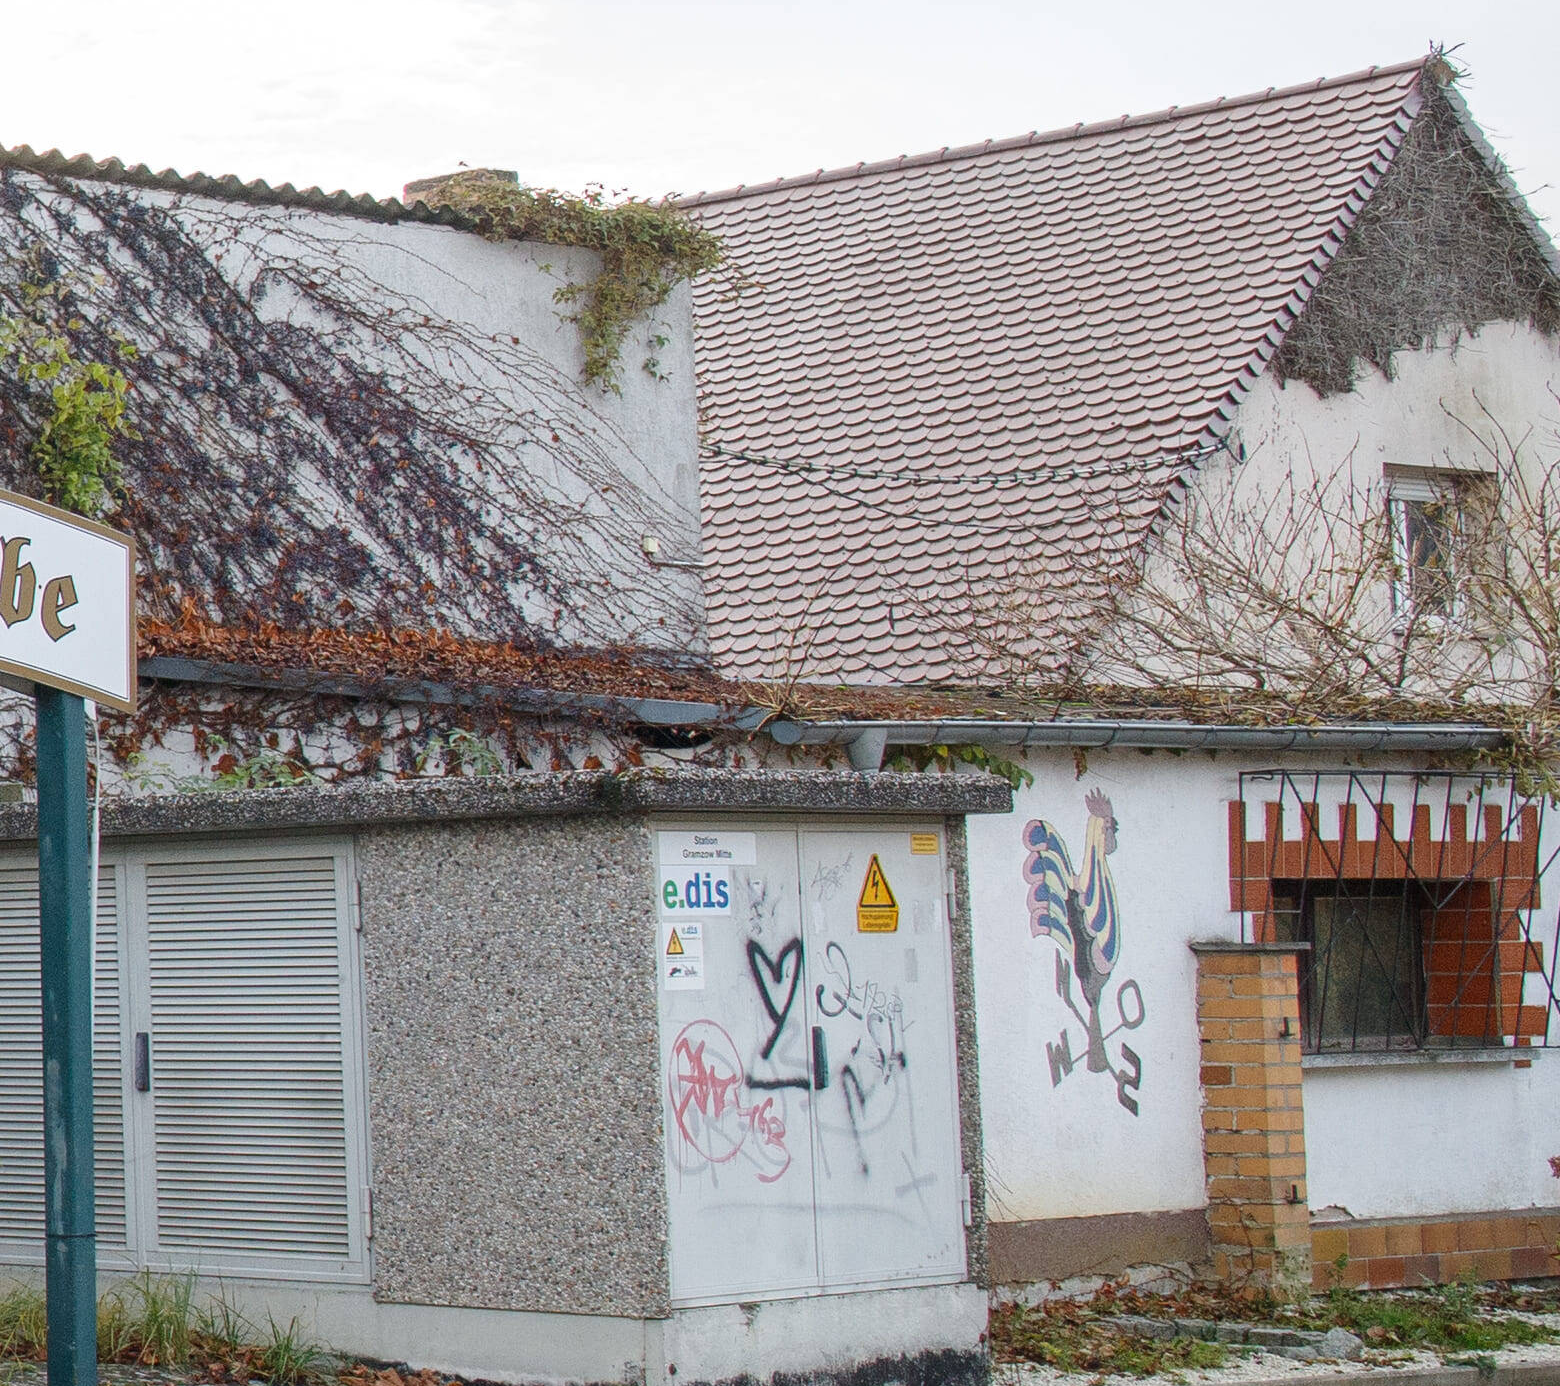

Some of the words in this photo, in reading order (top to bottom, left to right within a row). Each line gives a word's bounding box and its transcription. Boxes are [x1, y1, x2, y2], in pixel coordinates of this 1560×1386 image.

[693, 835, 719, 846] Station
[682, 848, 714, 859] Gramzow
[662, 872, 729, 909] e.dis
